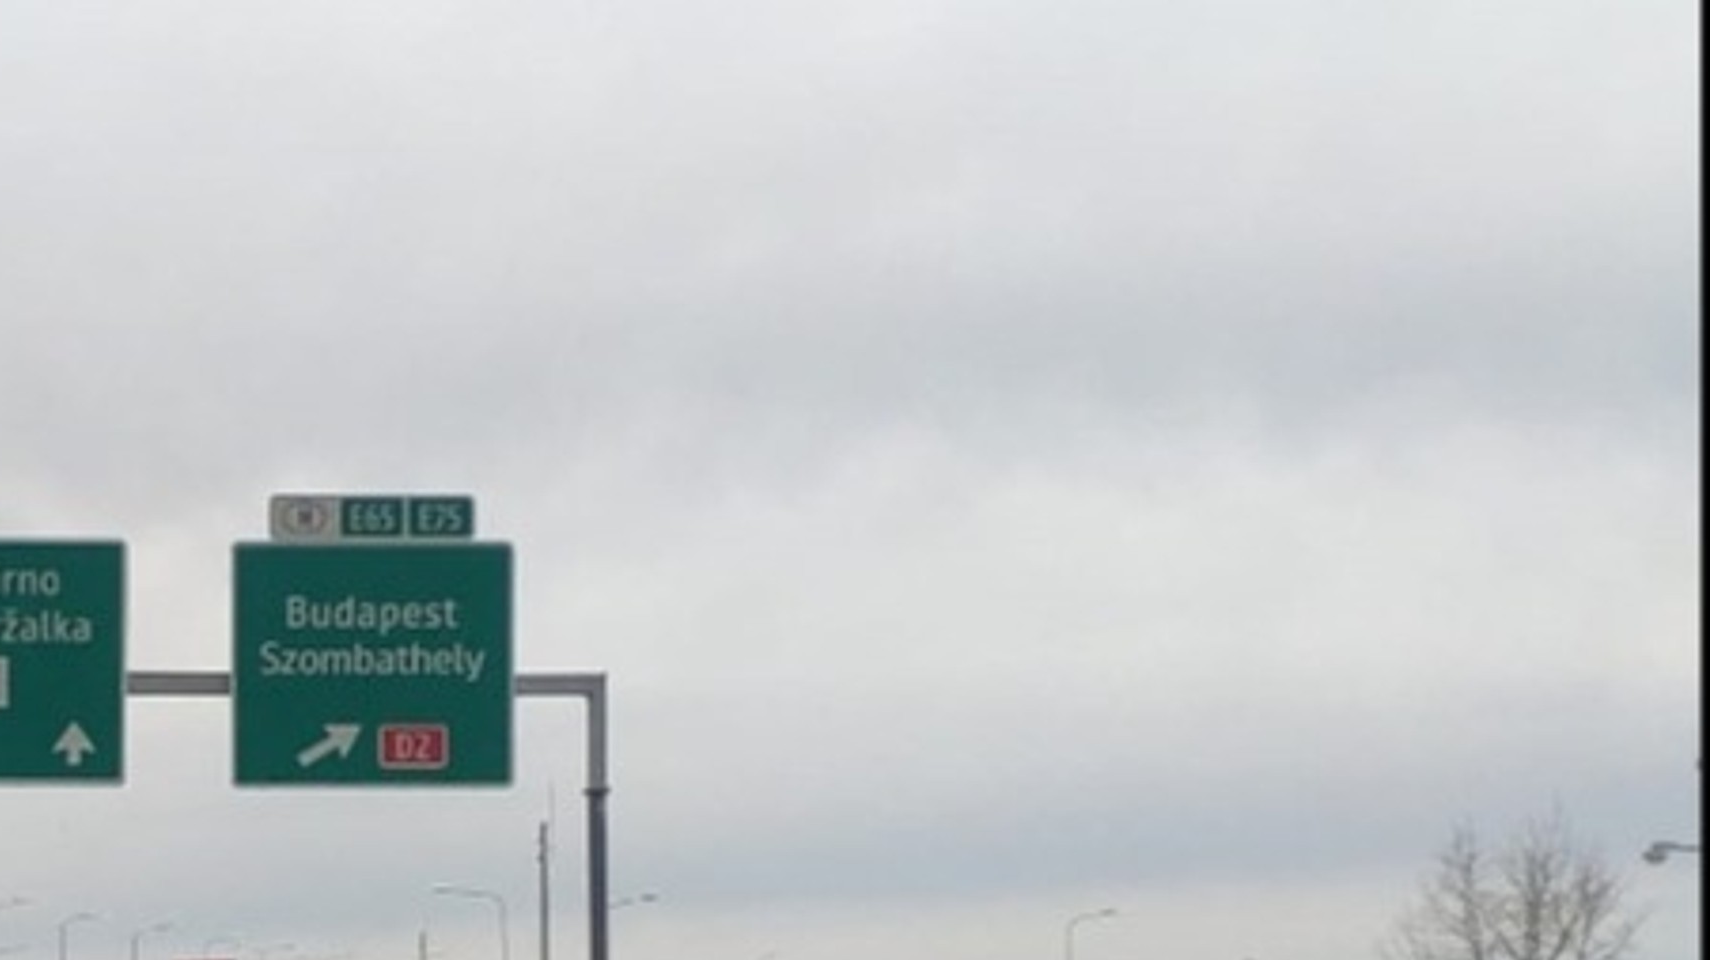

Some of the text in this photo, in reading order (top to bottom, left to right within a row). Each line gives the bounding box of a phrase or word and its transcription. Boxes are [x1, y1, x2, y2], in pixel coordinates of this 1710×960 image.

[348, 504, 394, 532] E65
[417, 503, 463, 532] E75
[285, 594, 459, 635] Budapest
[259, 641, 485, 682] Szombathely
[395, 732, 431, 760] D2
